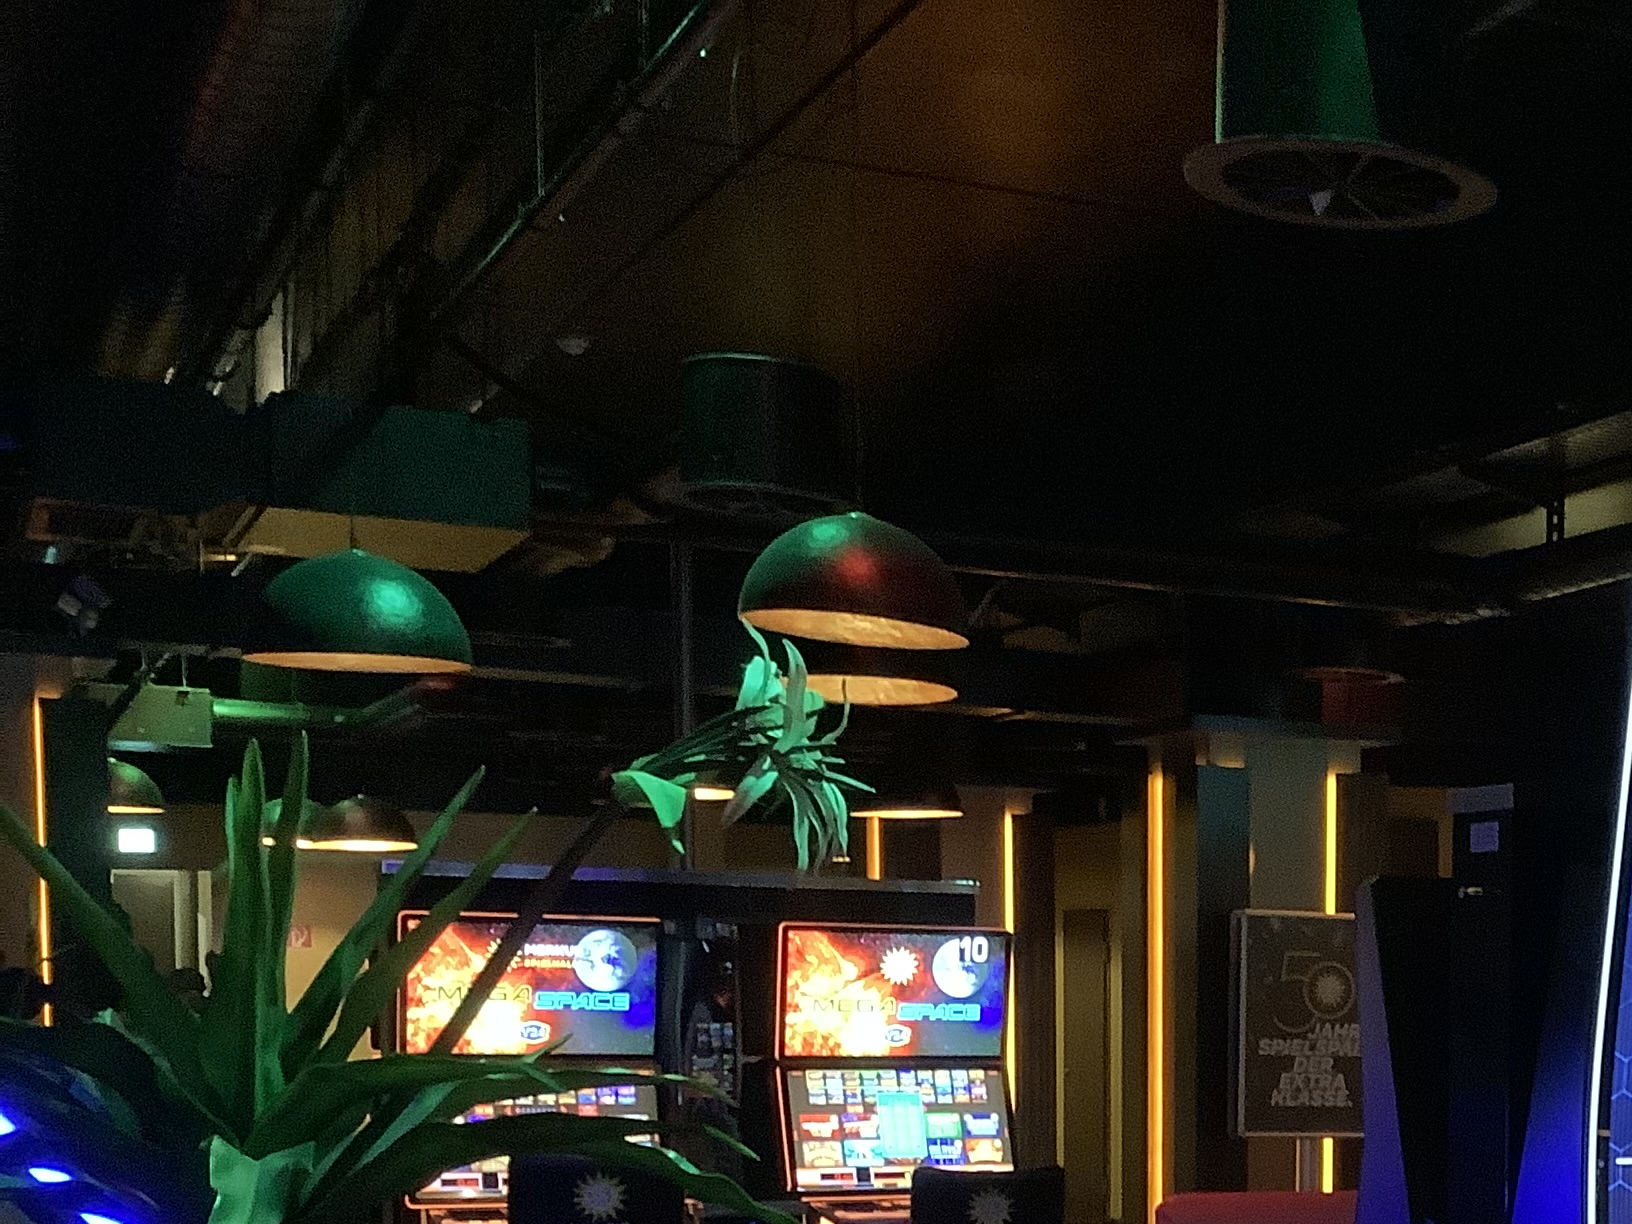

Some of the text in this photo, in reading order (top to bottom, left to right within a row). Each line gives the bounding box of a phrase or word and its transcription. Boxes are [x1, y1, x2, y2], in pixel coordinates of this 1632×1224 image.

[959, 935, 989, 963] 10
[438, 985, 630, 1011] MGA SPACE
[813, 998, 981, 1021] MEGA SPACE
